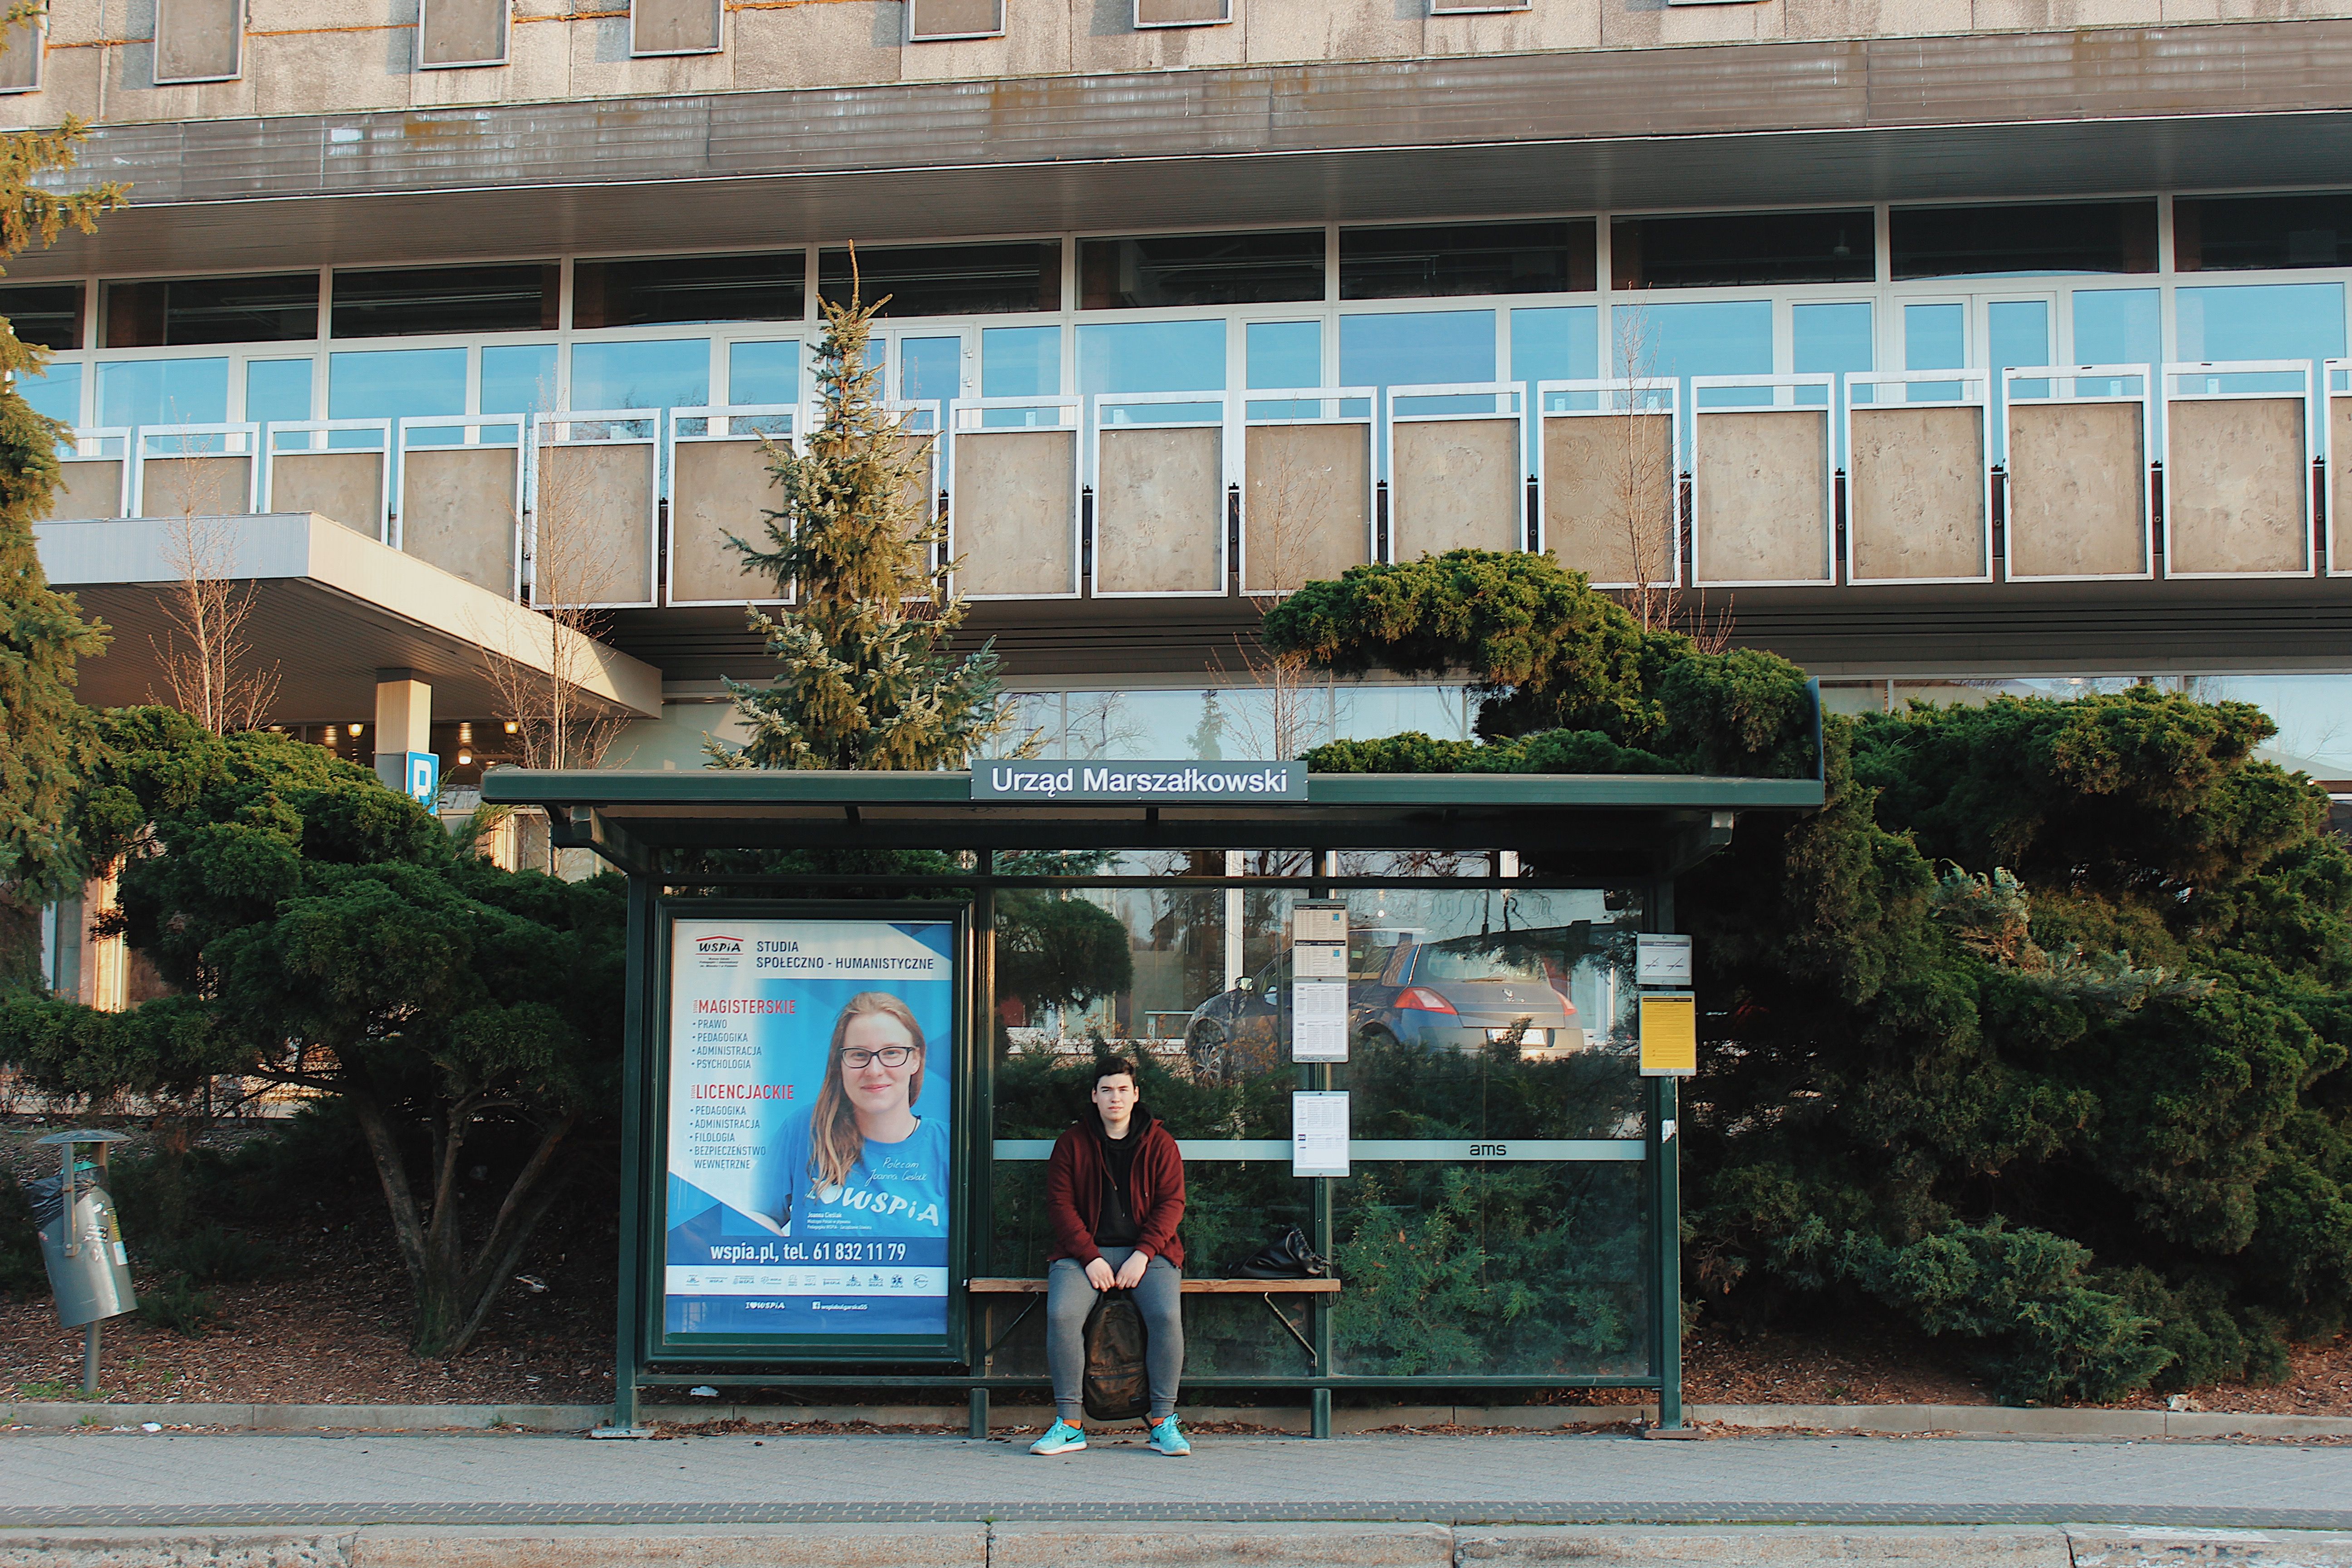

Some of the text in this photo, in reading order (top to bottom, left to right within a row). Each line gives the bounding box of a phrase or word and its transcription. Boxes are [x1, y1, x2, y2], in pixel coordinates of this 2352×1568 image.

[413, 759, 432, 803] P
[992, 767, 1287, 798] Urząd Marszałkowski
[757, 941, 799, 952] STUDIA
[756, 957, 823, 968] SPOŁECZNO
[836, 957, 934, 969] HUMANISTYCZNE
[698, 1000, 796, 1014] MAGISTERSKIE
[698, 1019, 727, 1029] PRAWO
[697, 1033, 748, 1042] PEDAGOGIKA
[696, 1046, 762, 1055] ADMINISTRACJA
[696, 1059, 751, 1068] PSYCHOLOGIA
[696, 1084, 794, 1099] LICENCJACKIE
[696, 1106, 746, 1115] PEDAGOGIKA
[695, 1119, 760, 1128] ADMINISTRACJA
[695, 1132, 735, 1142] FILOLOGIA
[695, 1144, 766, 1155] BEZPIECZEŃSTWO
[1470, 1145, 1506, 1156] ams
[694, 1159, 750, 1171] WEWNĘTRZNE
[882, 1157, 919, 1168] Polecam
[864, 1168, 898, 1187] Joanna
[710, 1242, 906, 1263] wspia.pl, tel. 61 832 11 79
